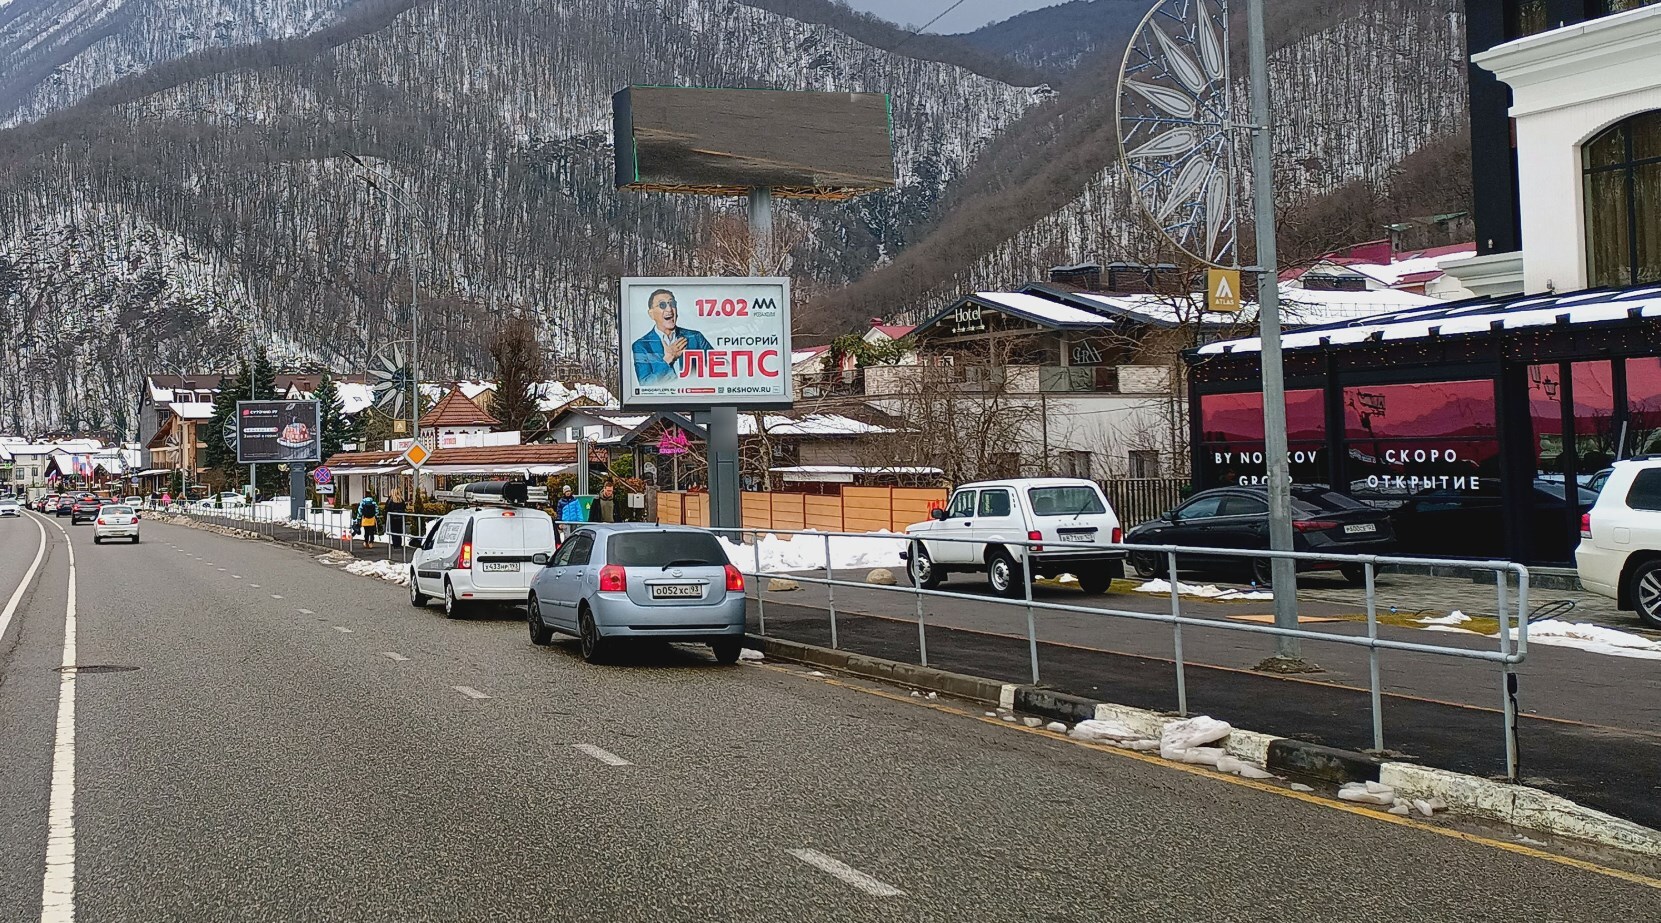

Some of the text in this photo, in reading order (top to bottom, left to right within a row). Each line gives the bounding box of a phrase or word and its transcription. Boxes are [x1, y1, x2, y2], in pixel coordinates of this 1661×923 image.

[696, 298, 749, 317] 17.02
[955, 305, 982, 323] Hotel
[717, 334, 779, 347] ГРИГОРИЙ
[680, 350, 779, 378] ЛЕПС
[1214, 452, 1232, 464] BY
[1385, 449, 1458, 463] СКОРО
[1367, 475, 1481, 490] ОТКРЫТИЕ
